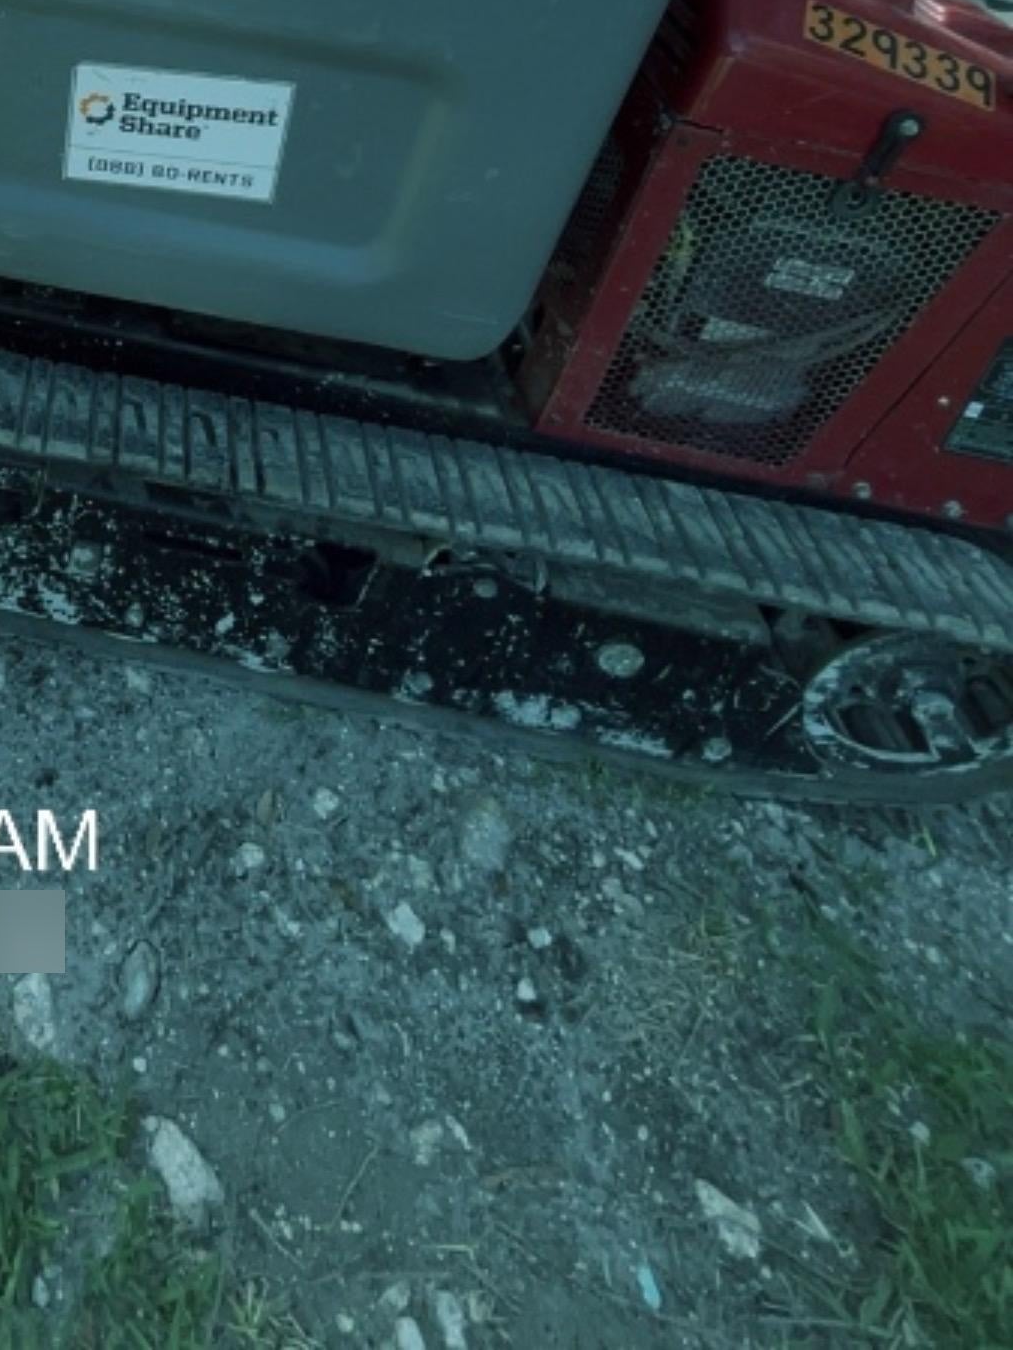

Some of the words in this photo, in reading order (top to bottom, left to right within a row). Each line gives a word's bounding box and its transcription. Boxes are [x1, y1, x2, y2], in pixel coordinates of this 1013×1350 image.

[809, 4, 992, 106] 329339
[121, 92, 279, 127] Equipment
[119, 115, 202, 140] Share
